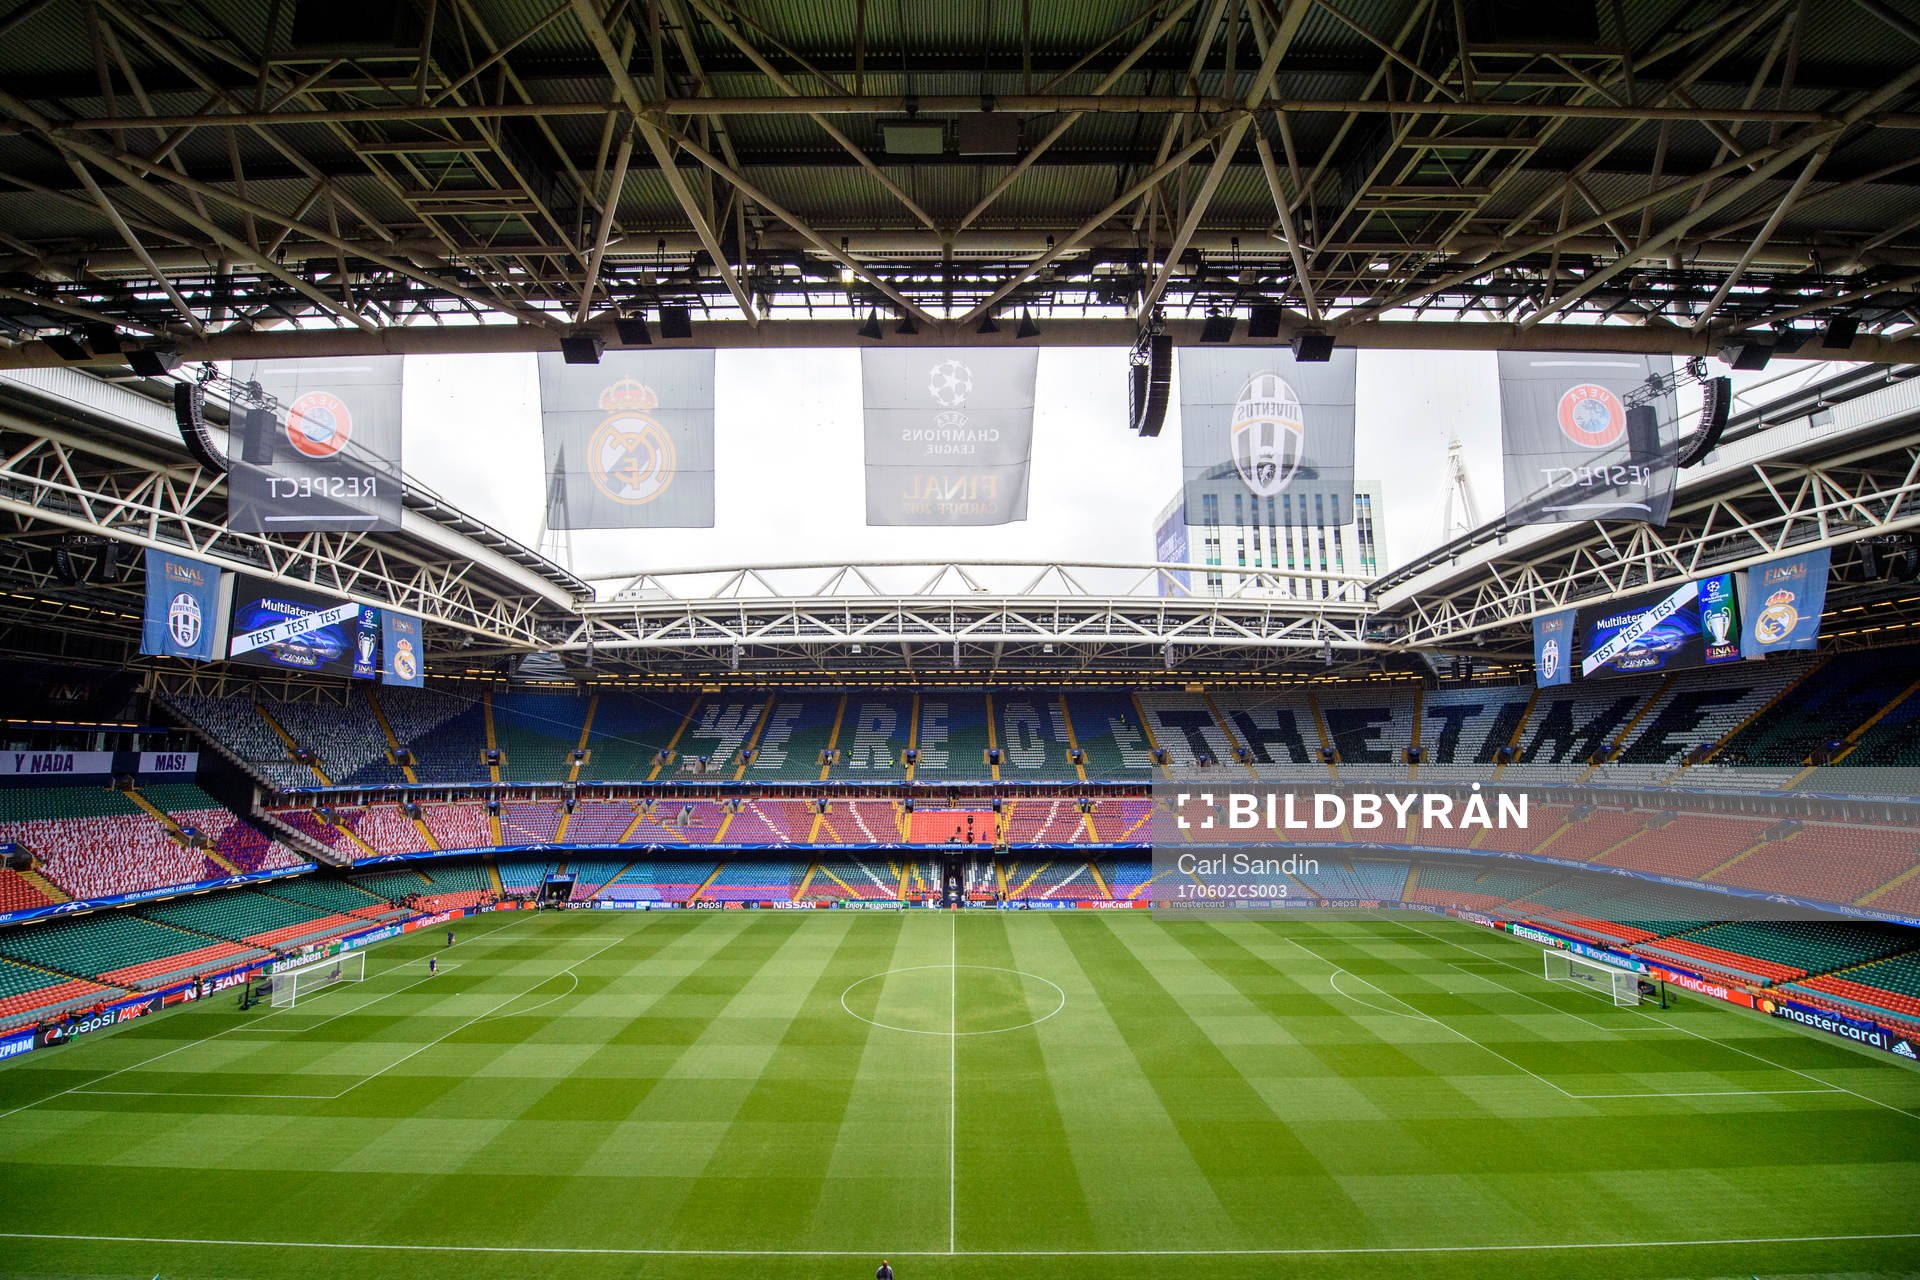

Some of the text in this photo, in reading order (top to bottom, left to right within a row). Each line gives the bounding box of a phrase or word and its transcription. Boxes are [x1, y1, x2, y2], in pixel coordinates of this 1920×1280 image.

[165, 562, 205, 580] FINAL
[1765, 562, 1807, 581] FINAL
[261, 598, 319, 617] Multilater
[248, 629, 276, 647] TEST
[285, 619, 310, 635] TEST
[318, 609, 341, 624] TEST
[1597, 611, 1650, 630] Multilater
[1593, 597, 1677, 664] TEST TEST TEST
[1705, 645, 1739, 657] FINAL
[15, 754, 74, 773] Y NADA
[154, 754, 187, 771] MAS!
[124, 883, 197, 900] UEFA CHAMPIONS LEAGUE
[1675, 879, 1706, 889] CHAMPIONS
[1706, 883, 1728, 893] LEAGUE
[697, 900, 723, 909] pepsi
[773, 901, 817, 909] NISSAN
[865, 901, 904, 910] Responsibly
[1100, 901, 1133, 909] UniCredit
[1172, 900, 1225, 908] mastercard
[1331, 900, 1357, 909] pepsi
[1408, 903, 1437, 912] RESPECT
[422, 913, 450, 927] UniCredit
[1457, 911, 1495, 928] NISSAN
[1839, 905, 1864, 916] FINAL
[1865, 910, 1902, 921] CARDIFF
[353, 930, 391, 947] PlayStation
[1512, 924, 1555, 947] Heineken
[272, 951, 321, 973] Heineken
[1586, 947, 1633, 969] PlayStation
[184, 972, 246, 1001] NSSAN
[1679, 975, 1728, 1000] UniCredit
[1777, 1005, 1882, 1047] mastercard
[1891, 1047, 1917, 1060] adidas
